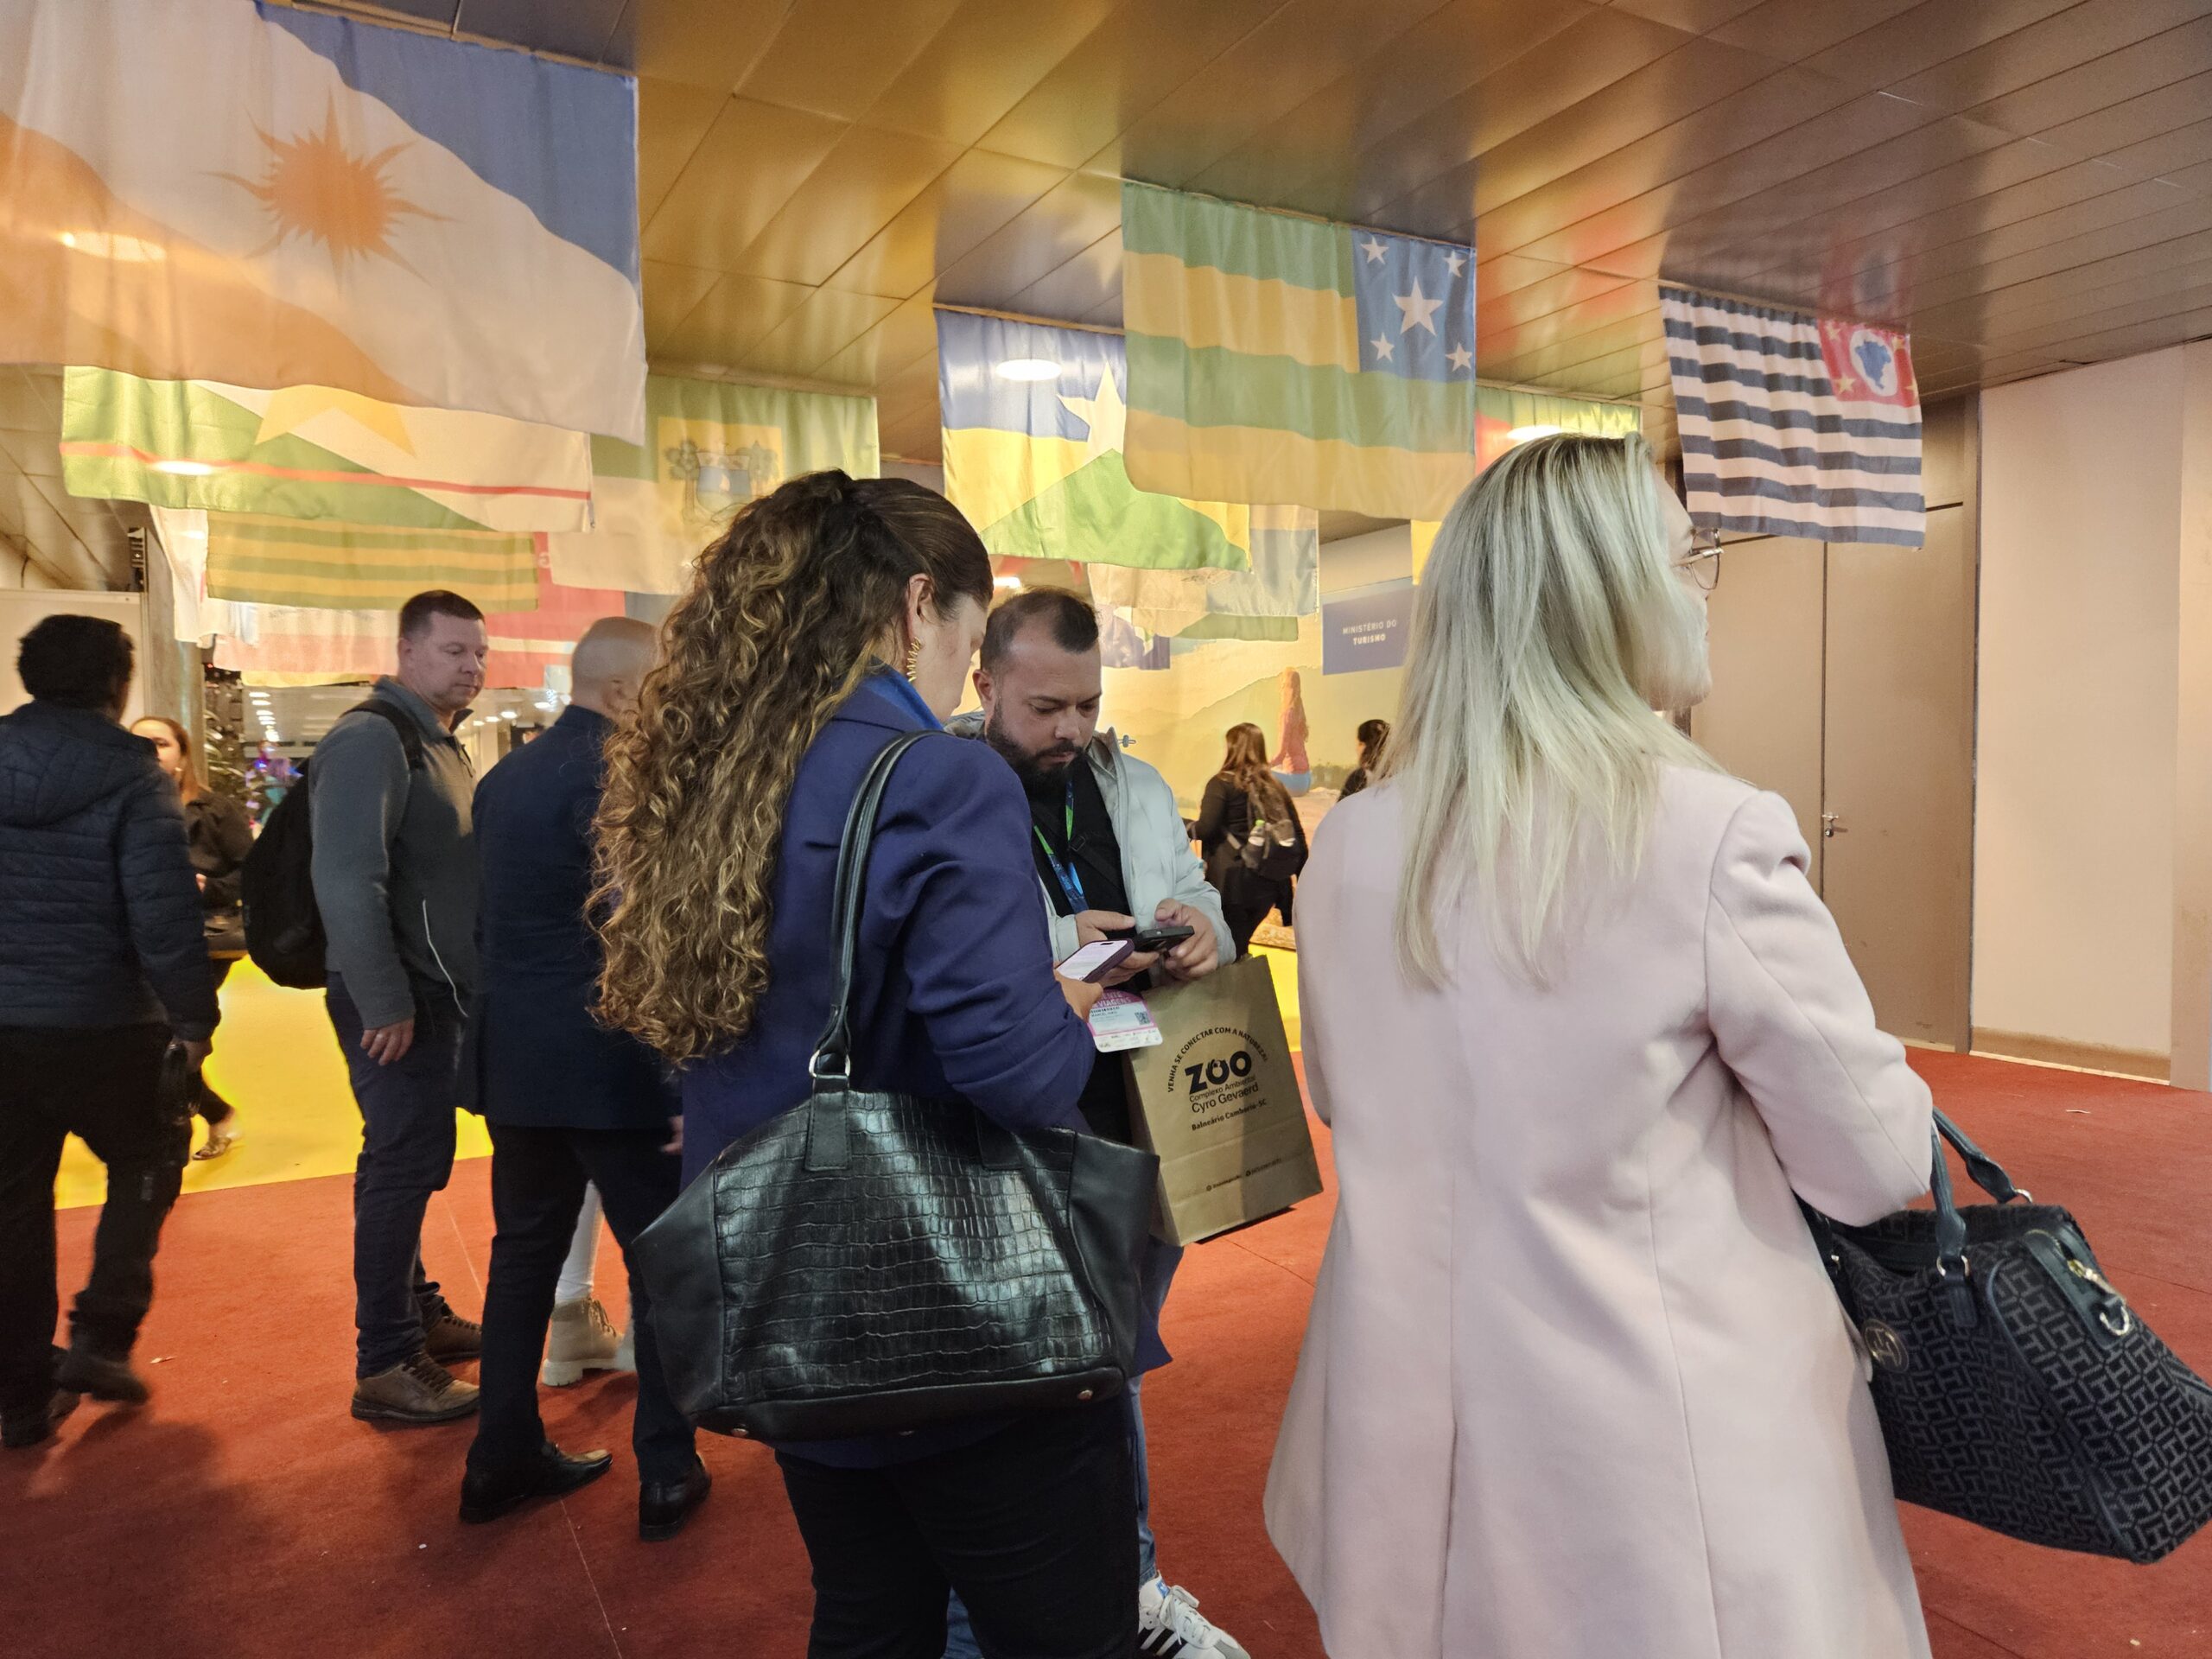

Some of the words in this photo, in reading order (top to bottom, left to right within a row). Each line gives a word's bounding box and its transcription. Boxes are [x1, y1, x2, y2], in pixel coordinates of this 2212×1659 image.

[1342, 621, 1384, 635] MINISTÉRIO
[1386, 620, 1397, 629] DO
[1352, 633, 1386, 645] TURISMO
[1168, 1065, 1178, 1093] VENHA
[1175, 1054, 1183, 1064] SE
[1180, 1028, 1213, 1054] CONECTAR
[1185, 1051, 1252, 1095] ZOO
[1189, 1086, 1224, 1103] Complexo
[1192, 1099, 1217, 1113] Cyro
[1217, 1082, 1259, 1104] Gevaerd
[1192, 1115, 1224, 1131] Balneário
